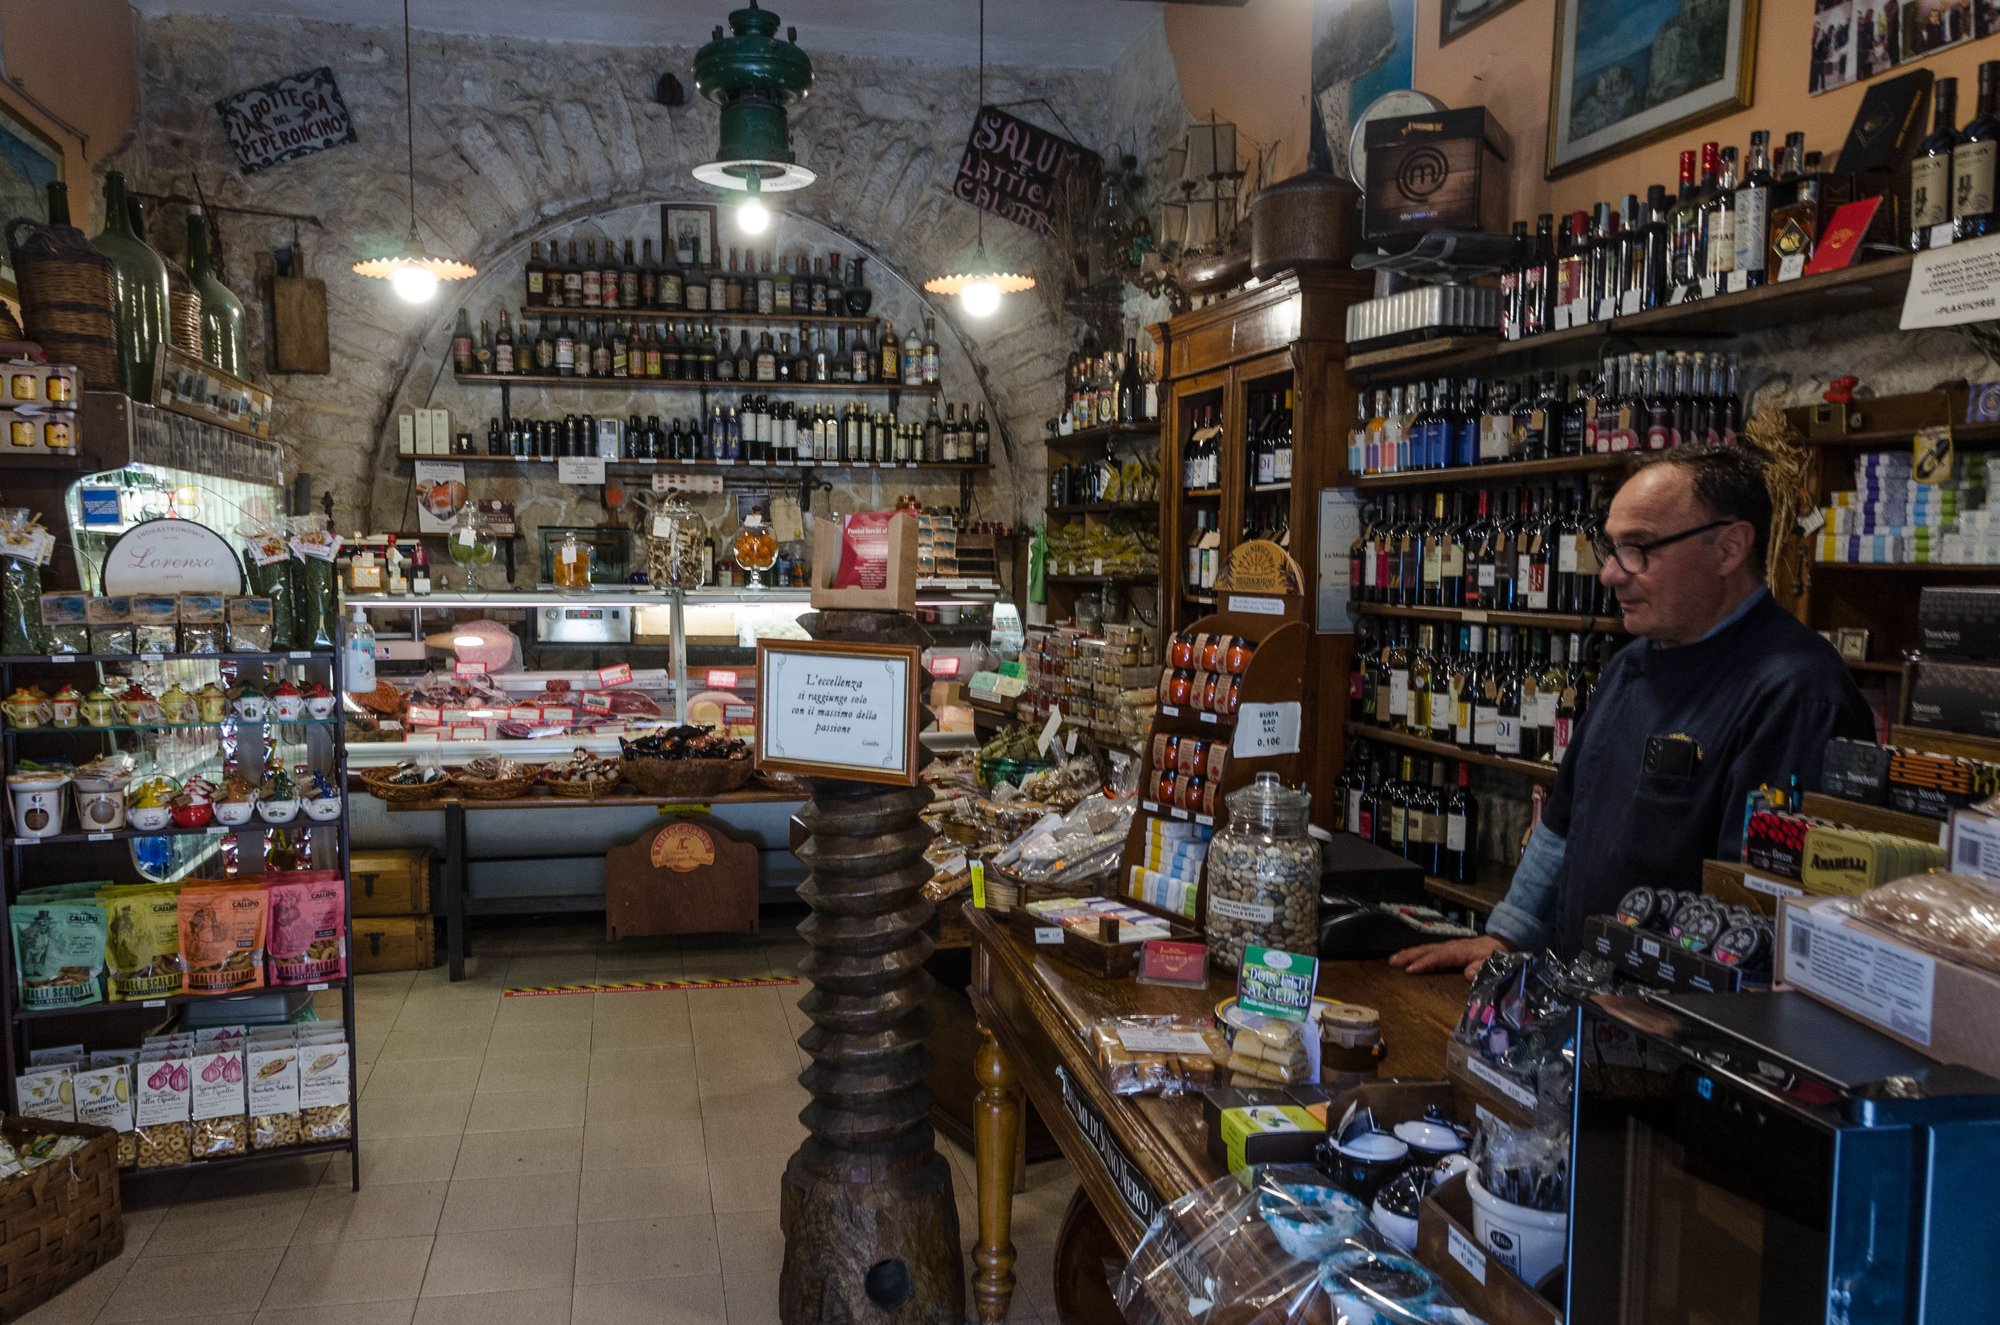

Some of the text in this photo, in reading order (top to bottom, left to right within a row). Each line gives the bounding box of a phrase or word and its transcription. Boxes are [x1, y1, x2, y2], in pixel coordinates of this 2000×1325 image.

[250, 88, 332, 119] BOTTEGA
[273, 114, 292, 127] DEL
[240, 115, 342, 161] PEPERONCINO
[128, 545, 216, 568] Lorenzo
[806, 674, 863, 692] L'eccellenza
[798, 690, 867, 706] si raggiunge solo
[791, 706, 877, 720] con il massimo della
[814, 722, 851, 734] passione
[1811, 853, 1867, 873] AMARELLI
[311, 892, 337, 900] CALLIPO
[153, 904, 177, 912] CALLIP
[232, 901, 259, 909] CALLIPO
[69, 914, 98, 922] CALLIPO
[305, 960, 339, 973] SCALDATI
[220, 968, 255, 983] SCALDATI
[1251, 967, 1308, 992] DOLCETTI
[53, 983, 92, 999] SCALDATI
[1248, 983, 1264, 997] AL
[1267, 986, 1308, 1007] CEDRO
[1089, 1119, 1099, 1143] DI
[1120, 1160, 1148, 1216] NERO
